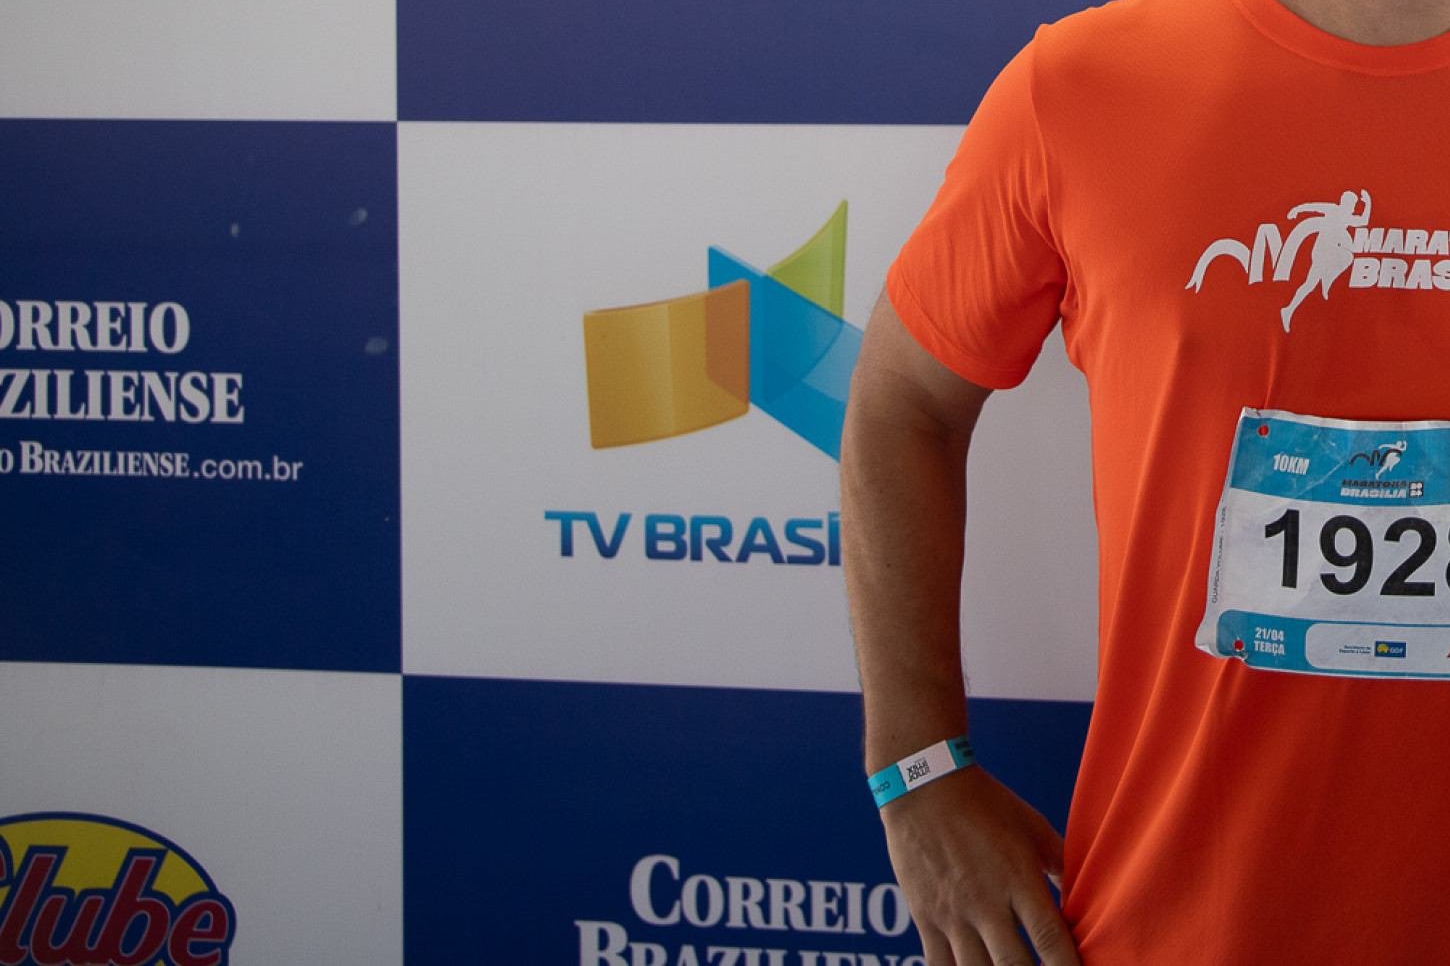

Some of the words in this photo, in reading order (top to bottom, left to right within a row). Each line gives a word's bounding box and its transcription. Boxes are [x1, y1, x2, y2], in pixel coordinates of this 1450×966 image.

[1273, 453, 1310, 475] 10KM
[544, 511, 632, 559] TV
[1254, 627, 1285, 642] 21/04
[1254, 639, 1286, 656] TERÇA
[629, 854, 913, 936] CORREIO
